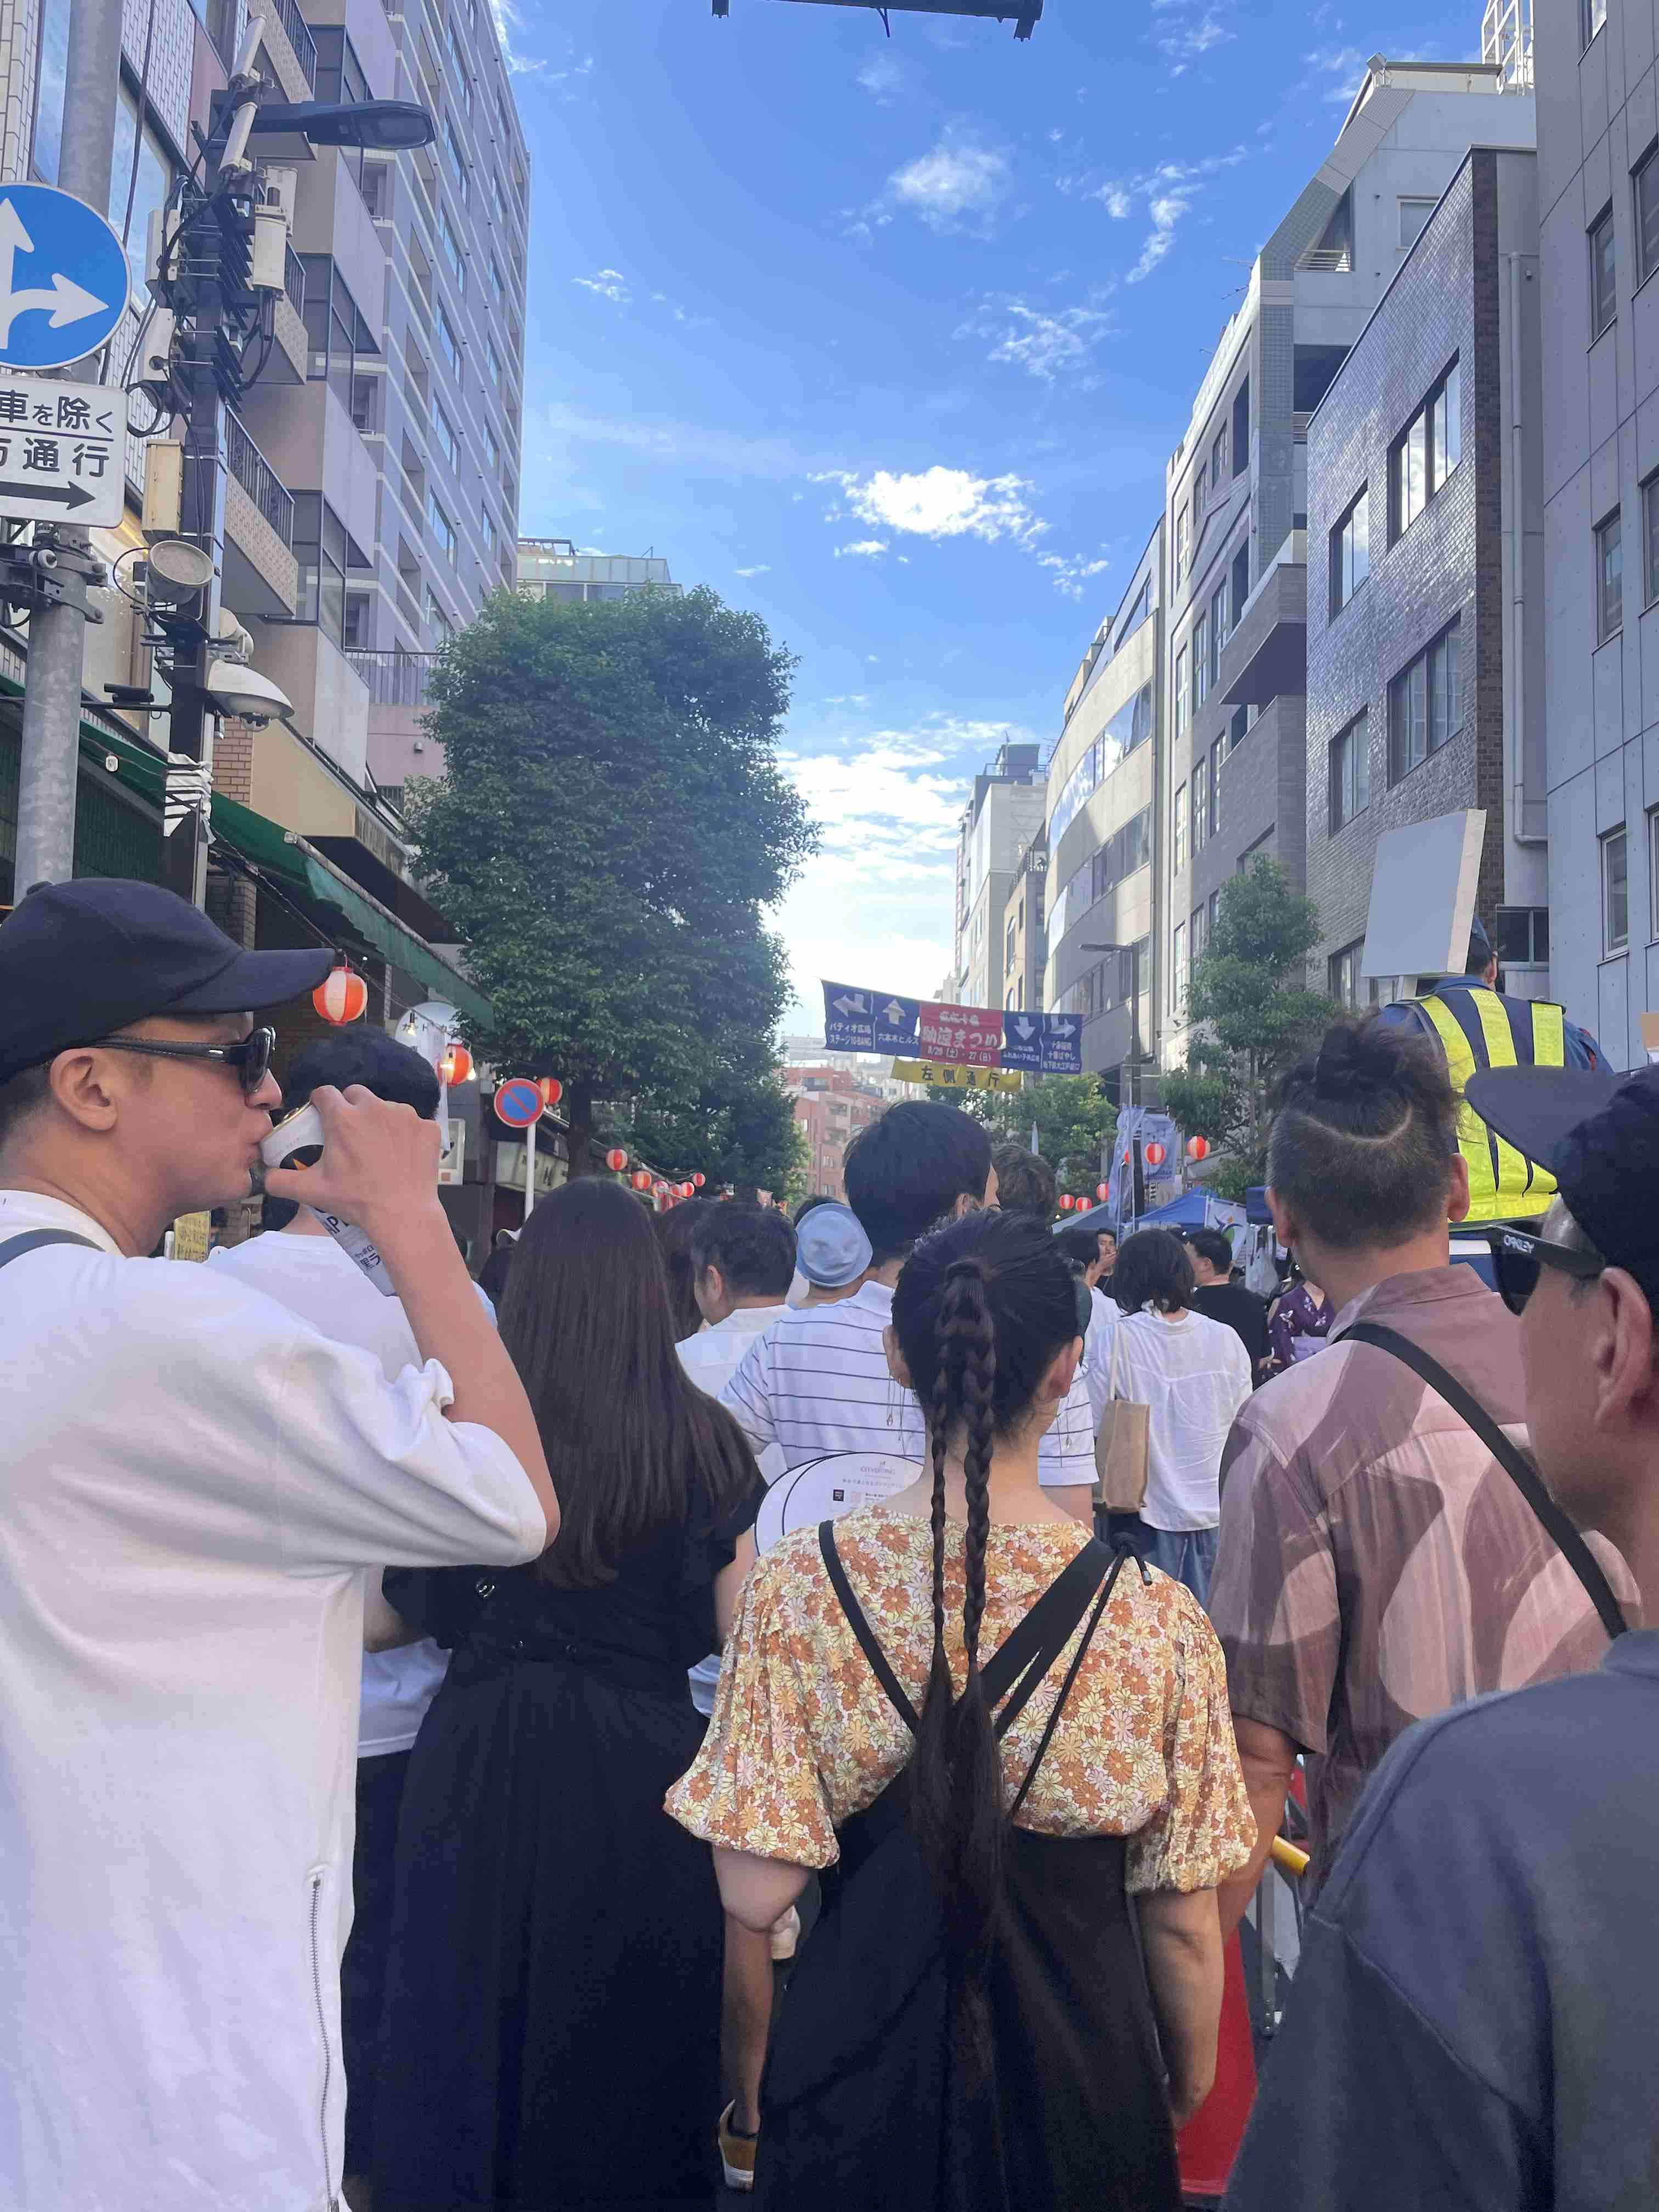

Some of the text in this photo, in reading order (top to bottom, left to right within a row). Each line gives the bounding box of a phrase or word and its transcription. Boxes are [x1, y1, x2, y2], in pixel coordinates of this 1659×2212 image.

[0, 390, 113, 433] 車を除く
[922, 1064, 1000, 1087] 左側通行
